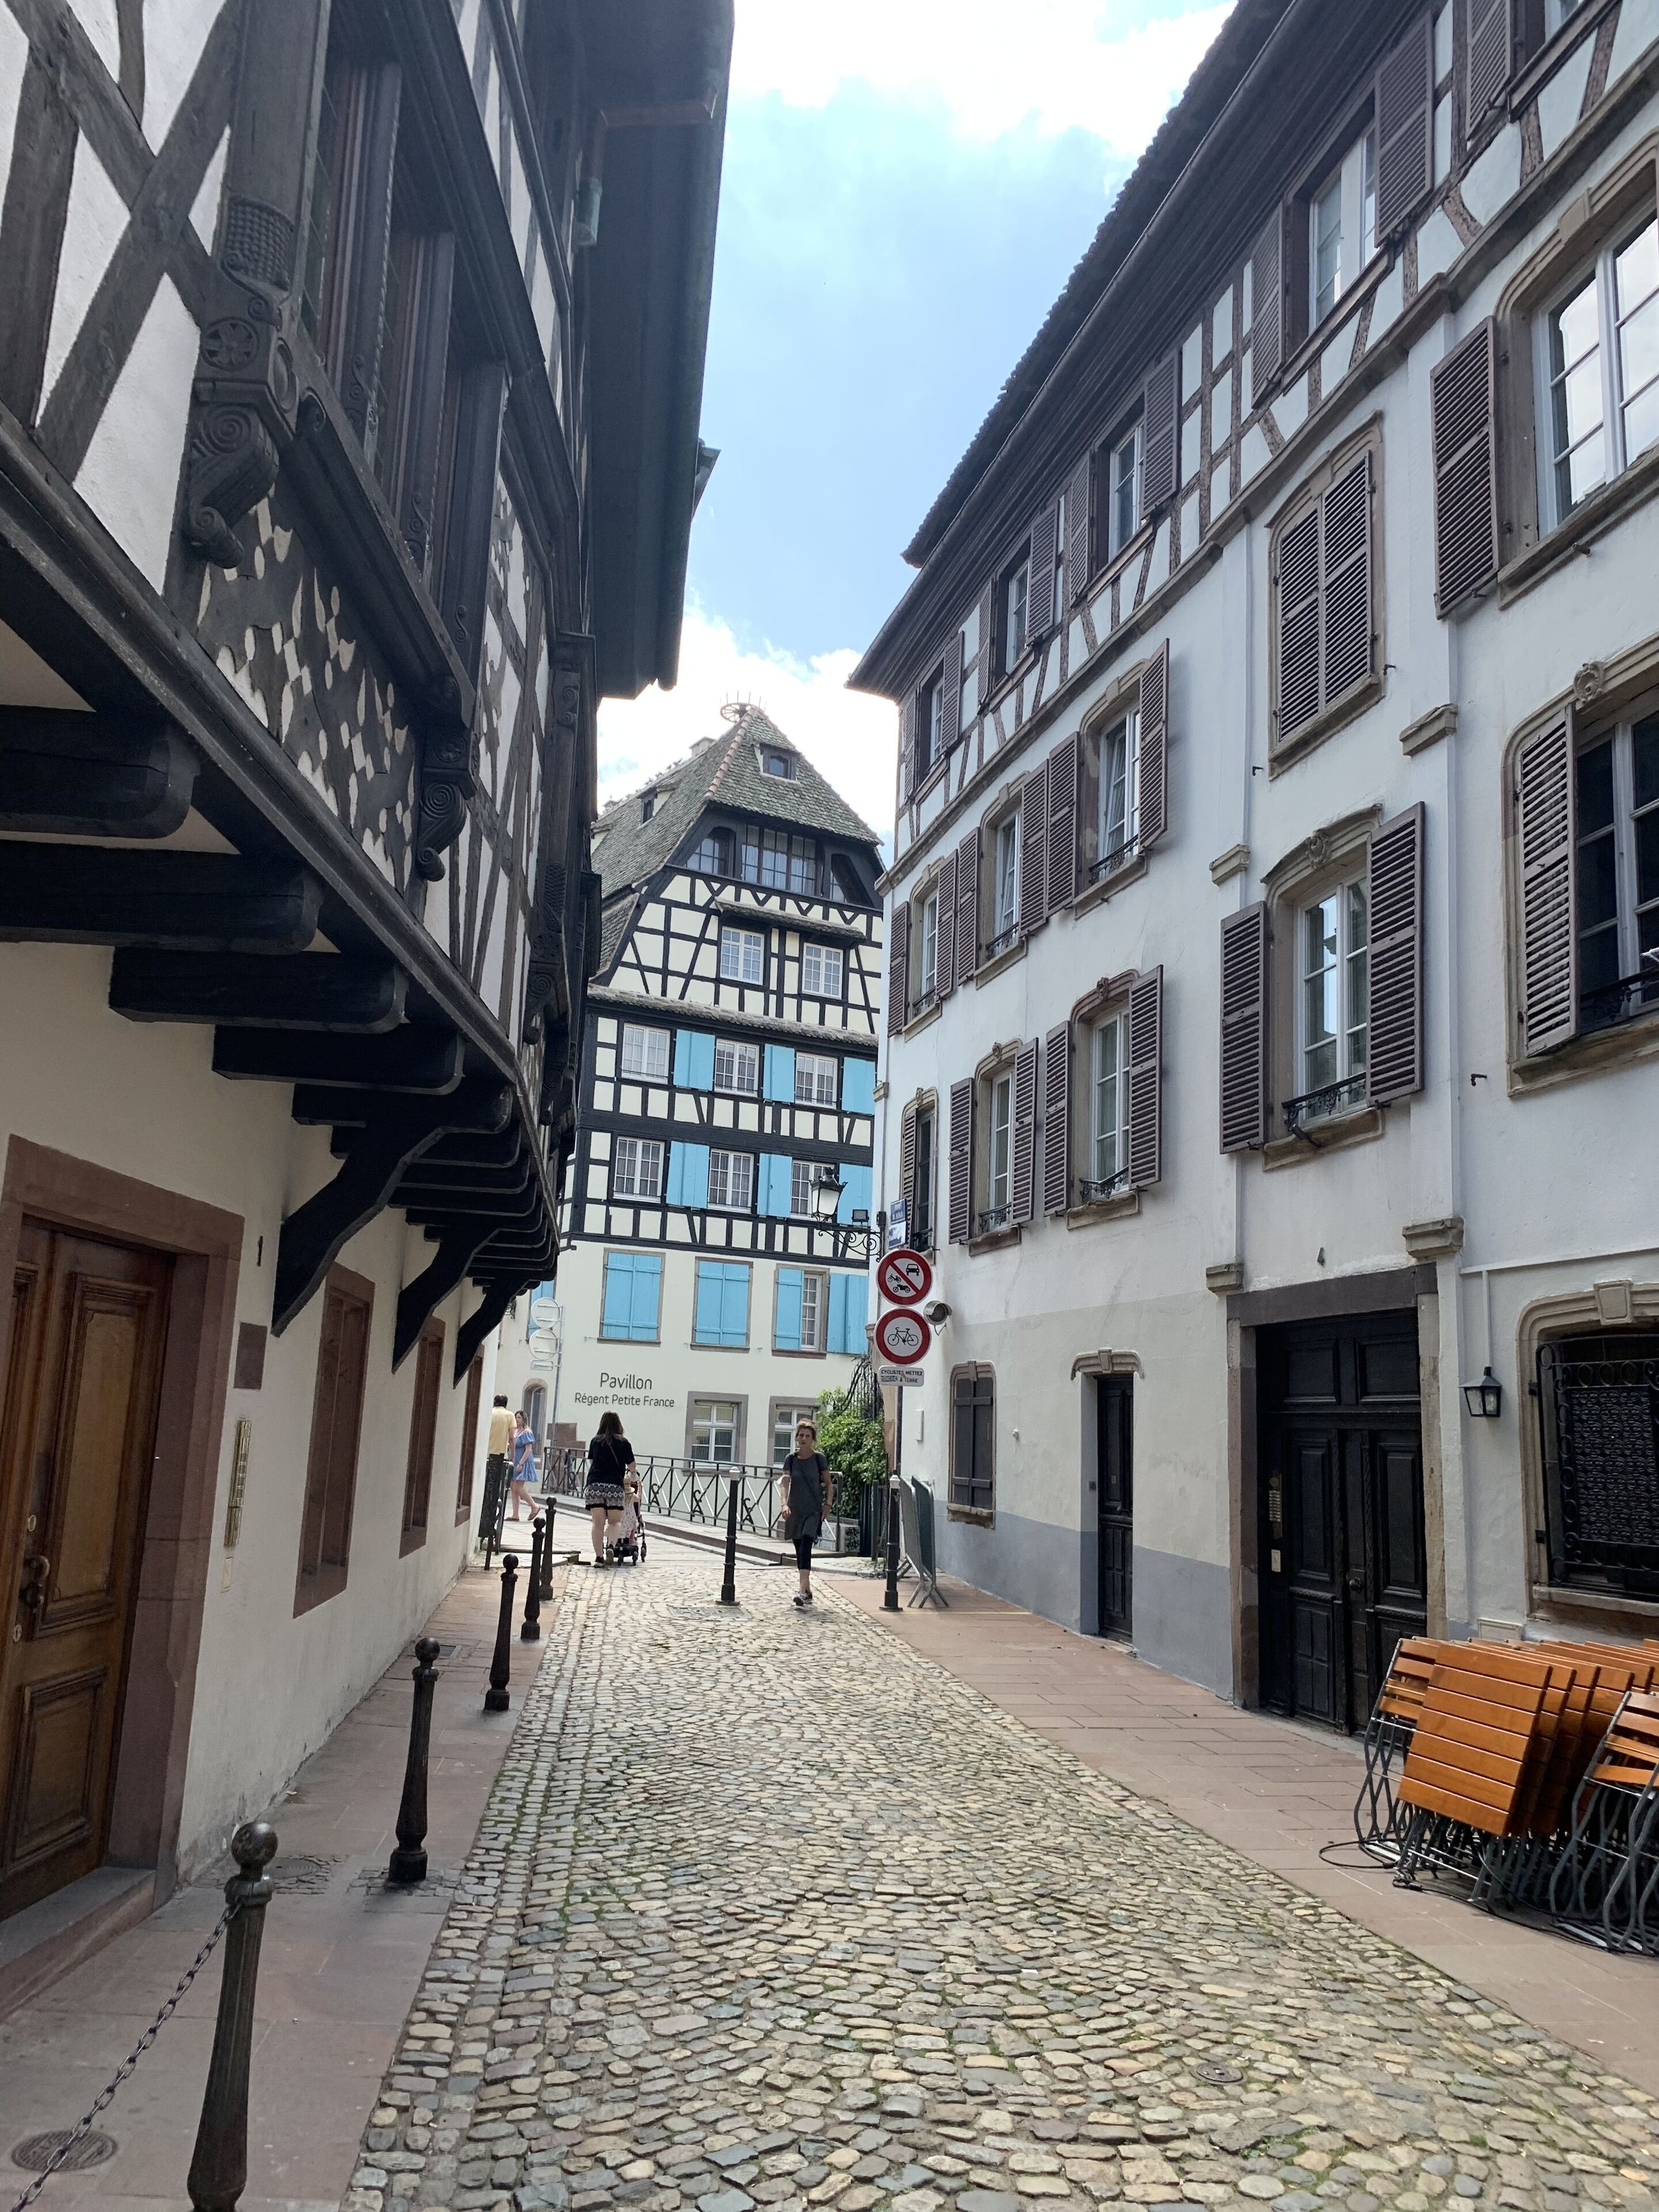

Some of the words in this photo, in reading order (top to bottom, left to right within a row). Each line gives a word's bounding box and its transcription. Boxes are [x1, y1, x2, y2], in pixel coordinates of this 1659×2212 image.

[600, 1372, 653, 1390] Pavillon
[574, 1392, 609, 1406] Régent
[612, 1393, 641, 1406] Petite
[643, 1395, 675, 1407] France
